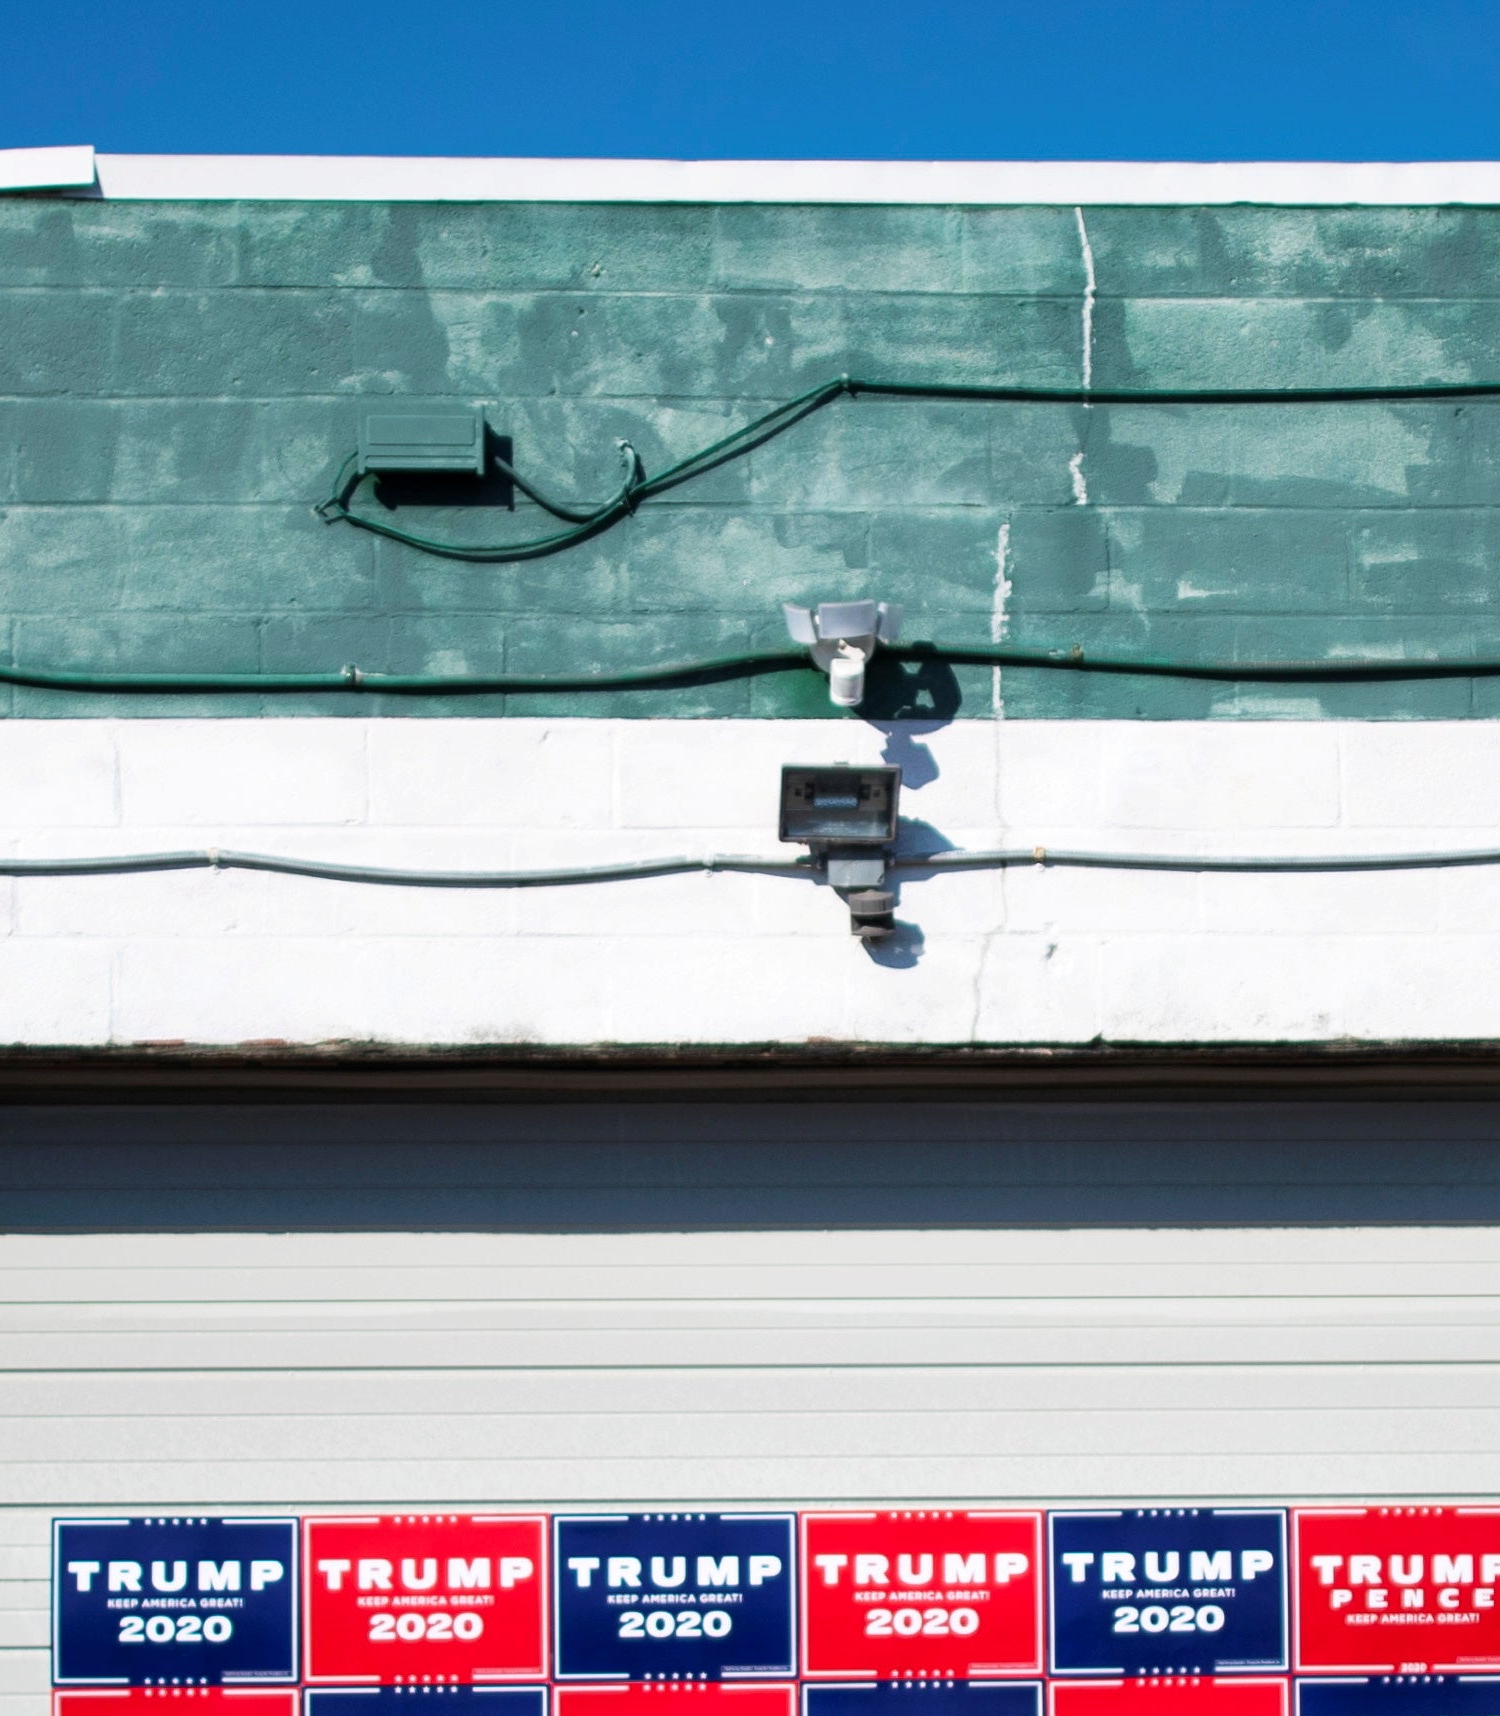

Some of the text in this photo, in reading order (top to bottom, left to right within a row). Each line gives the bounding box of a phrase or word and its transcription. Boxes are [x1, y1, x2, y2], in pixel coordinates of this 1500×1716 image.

[68, 1561, 283, 1592] TRUMP
[318, 1557, 533, 1590] TRUMP
[568, 1556, 781, 1587] TRUMP
[815, 1553, 1028, 1585] TRUMP
[1063, 1551, 1273, 1582] TRUMP
[107, 1598, 242, 1609] KEEP AMERICA GREAT!
[358, 1595, 494, 1607] KEEP AMERICA GREAT!
[607, 1593, 742, 1604] KEEP AMERICA GREAT!
[855, 1590, 990, 1602] KEEP AMERICA GREAT!
[1102, 1588, 1235, 1599] KEEP AMERICA GREAT!
[1331, 1589, 1494, 1608] PENCE
[119, 1616, 231, 1642] 2020
[369, 1613, 483, 1640] 2020
[619, 1611, 731, 1638] 2020
[866, 1608, 979, 1635] 2020
[1114, 1606, 1224, 1632] 2020
[1347, 1613, 1480, 1624] KEEP AMERICA GREAT!
[1400, 1662, 1427, 1673] 2020
